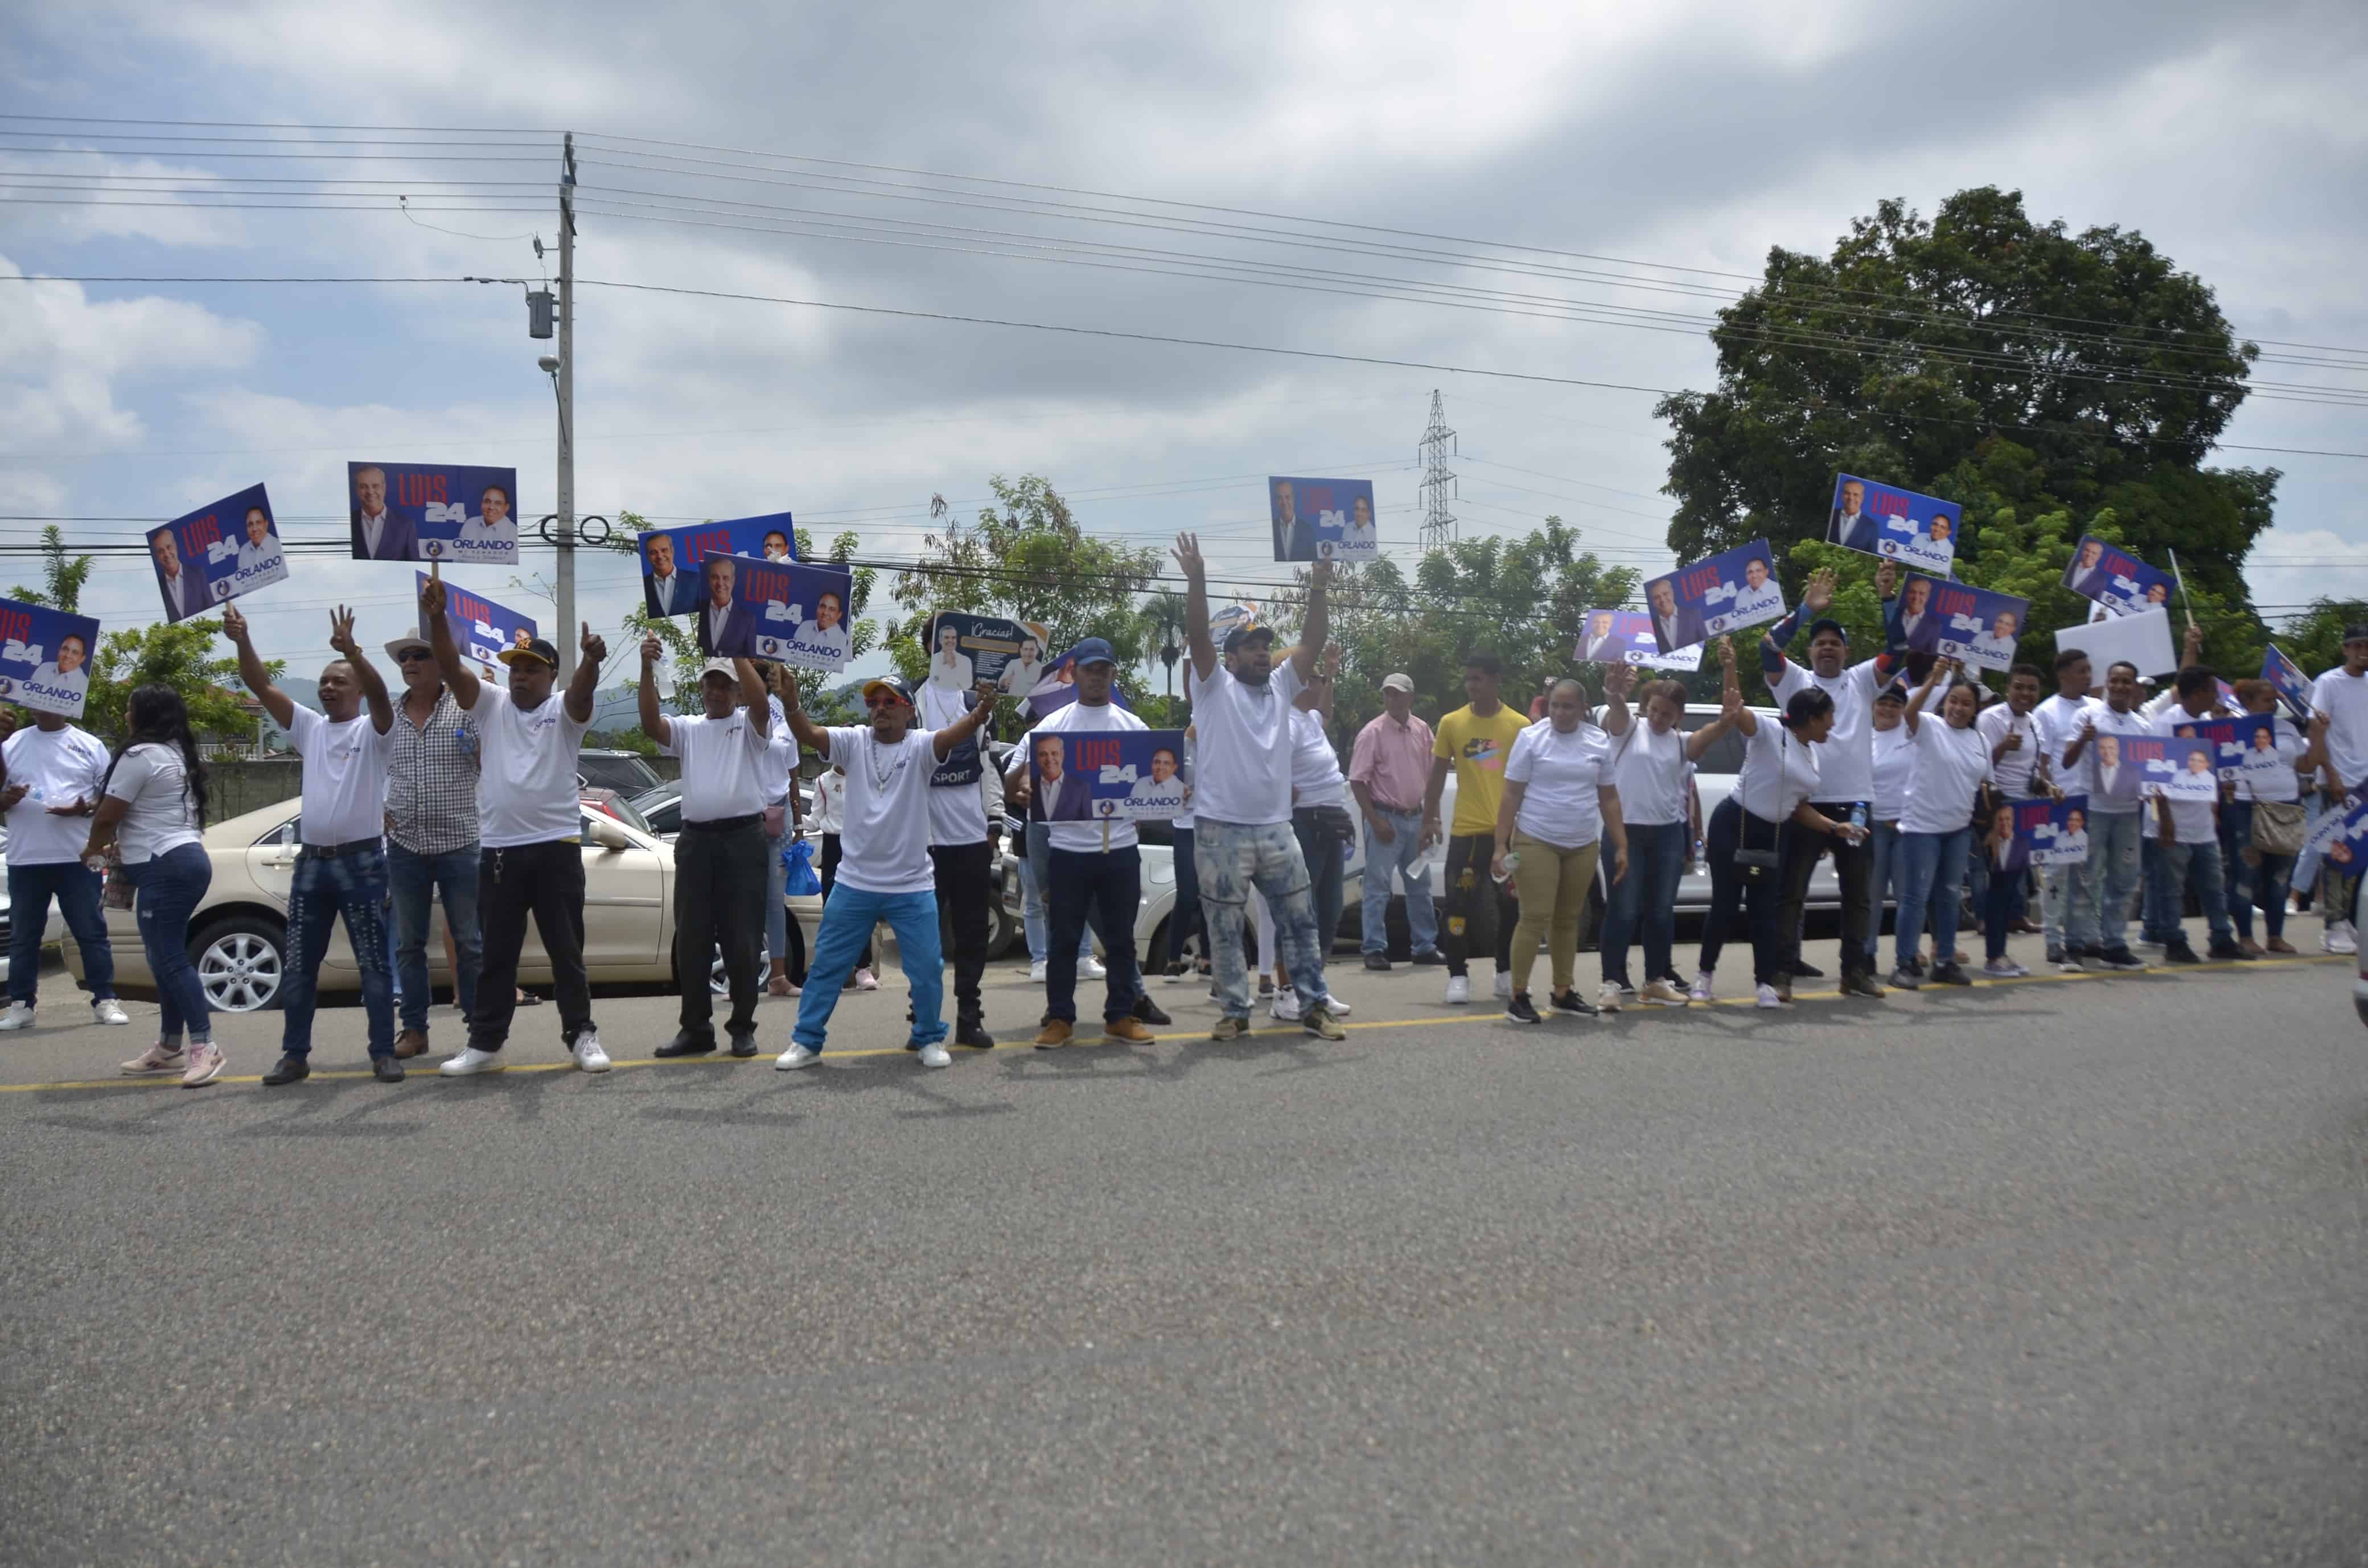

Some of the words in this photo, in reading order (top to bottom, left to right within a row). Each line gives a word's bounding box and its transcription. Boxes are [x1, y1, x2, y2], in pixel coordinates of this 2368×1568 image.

[399, 473, 447, 507] LUIS
[425, 501, 466, 523] 24
[1872, 491, 1909, 519] LUIS
[1319, 509, 1345, 528] 24
[1886, 514, 1919, 535] 24
[182, 514, 221, 557] LUIS
[453, 539, 514, 550] ORLANDO
[207, 534, 239, 565] 24
[1904, 545, 1950, 563] ORLANDO
[235, 555, 281, 581] ORLANDO
[745, 567, 789, 605] LUIS
[1680, 565, 1721, 601] LUIS
[1704, 580, 1737, 606] 24
[2113, 574, 2140, 594] 24
[454, 592, 491, 627] LUIS
[765, 599, 803, 624] 24
[1732, 596, 1779, 618] ORLANDO
[1937, 588, 1977, 618] LUIS
[0, 607, 31, 645] UIS
[475, 619, 505, 644] 24
[971, 622, 1014, 639] ¡Gracias!
[1950, 612, 1984, 633] 24
[2, 637, 43, 666] 24
[787, 640, 841, 657] ORLANDO
[1964, 644, 2010, 661] ORLANDO
[23, 681, 82, 702] ORLANDO
[1076, 739, 1121, 771] LUIS
[2127, 742, 2165, 763] LUIS
[2221, 740, 2246, 758] 24
[933, 770, 970, 783] SPORT
[1099, 764, 1137, 783] 24
[2146, 759, 2177, 773] 24
[2167, 783, 2214, 792] ORLANDO
[1124, 797, 1180, 806] ORLANDO
[2034, 822, 2059, 839] 24
